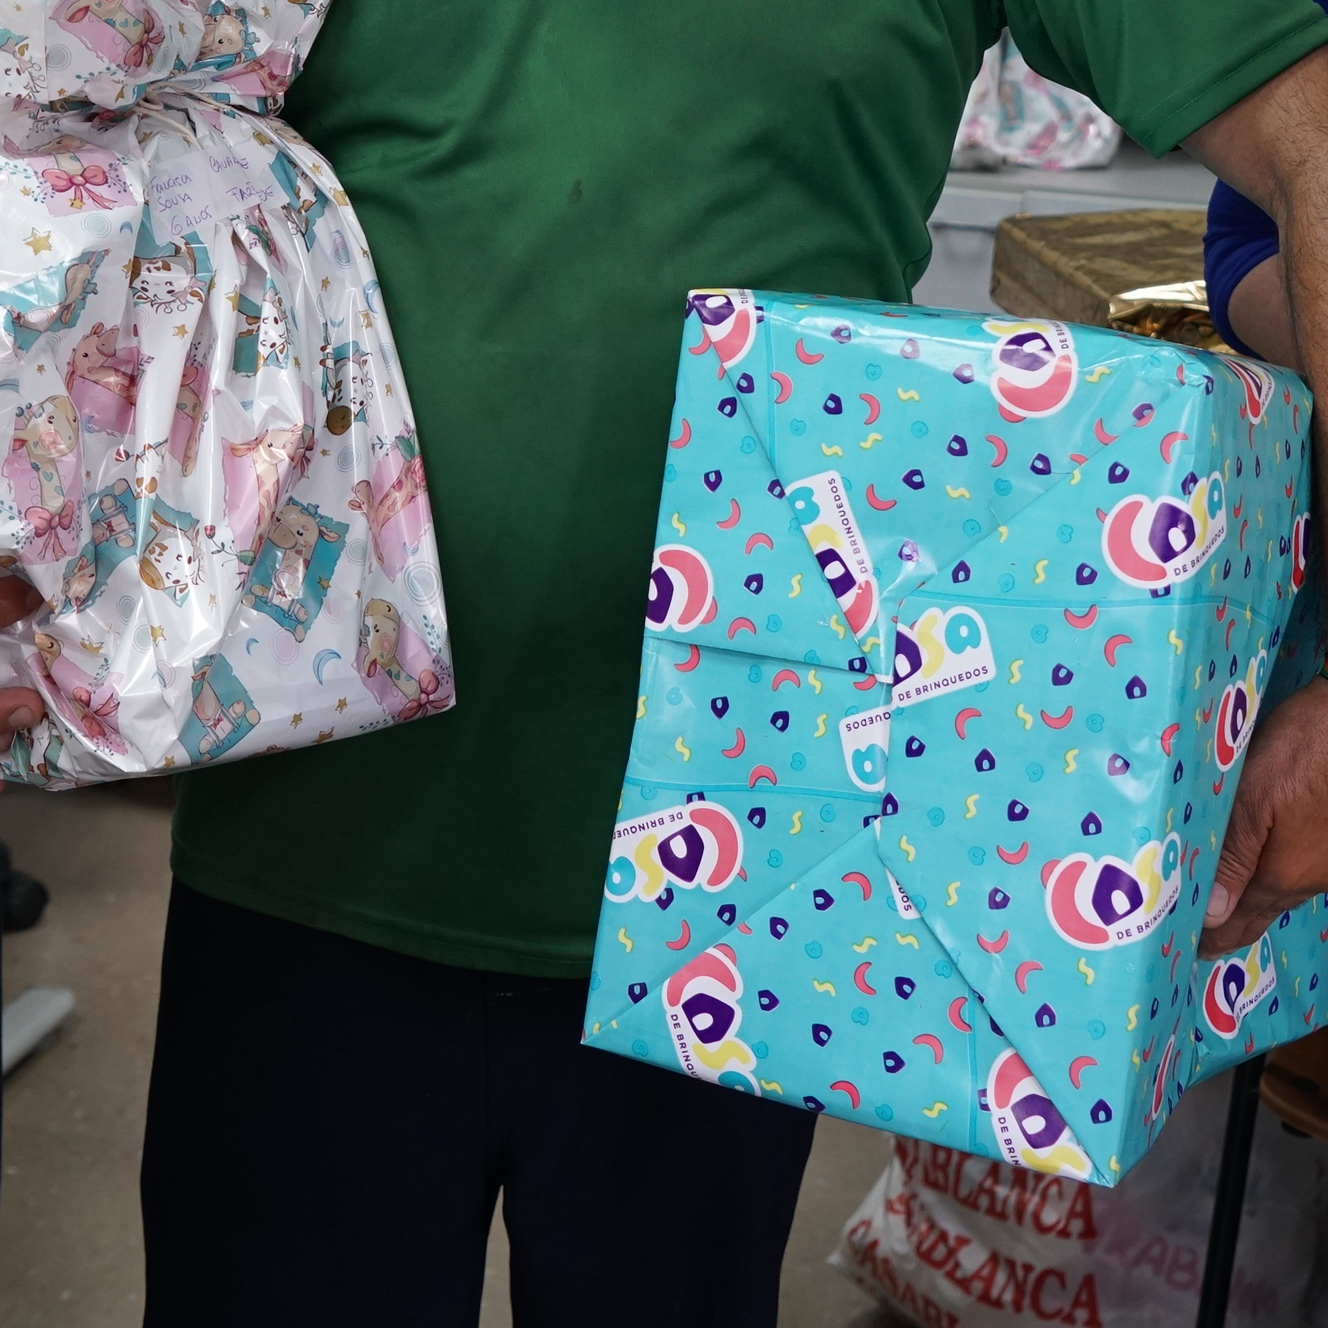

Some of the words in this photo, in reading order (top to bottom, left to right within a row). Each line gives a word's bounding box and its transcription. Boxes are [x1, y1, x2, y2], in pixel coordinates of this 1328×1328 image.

[1058, 337, 1069, 350] DE
[827, 477, 862, 555] BRINQUEDOS
[1173, 563, 1189, 577] DE
[1190, 525, 1225, 569] BRINQUEDOS
[856, 558, 869, 574] DE
[897, 690, 912, 702] DE
[915, 665, 989, 696] BRINQUEDOS
[845, 711, 892, 732] QUEDOS
[613, 816, 665, 840] BRINQUE
[668, 811, 684, 823] DE
[1116, 928, 1133, 940] DE
[1136, 885, 1179, 934] BRINQUEDOS
[670, 1014, 682, 1030] DE
[676, 1033, 700, 1079] BRINQU
[997, 1116, 1009, 1133] DE
